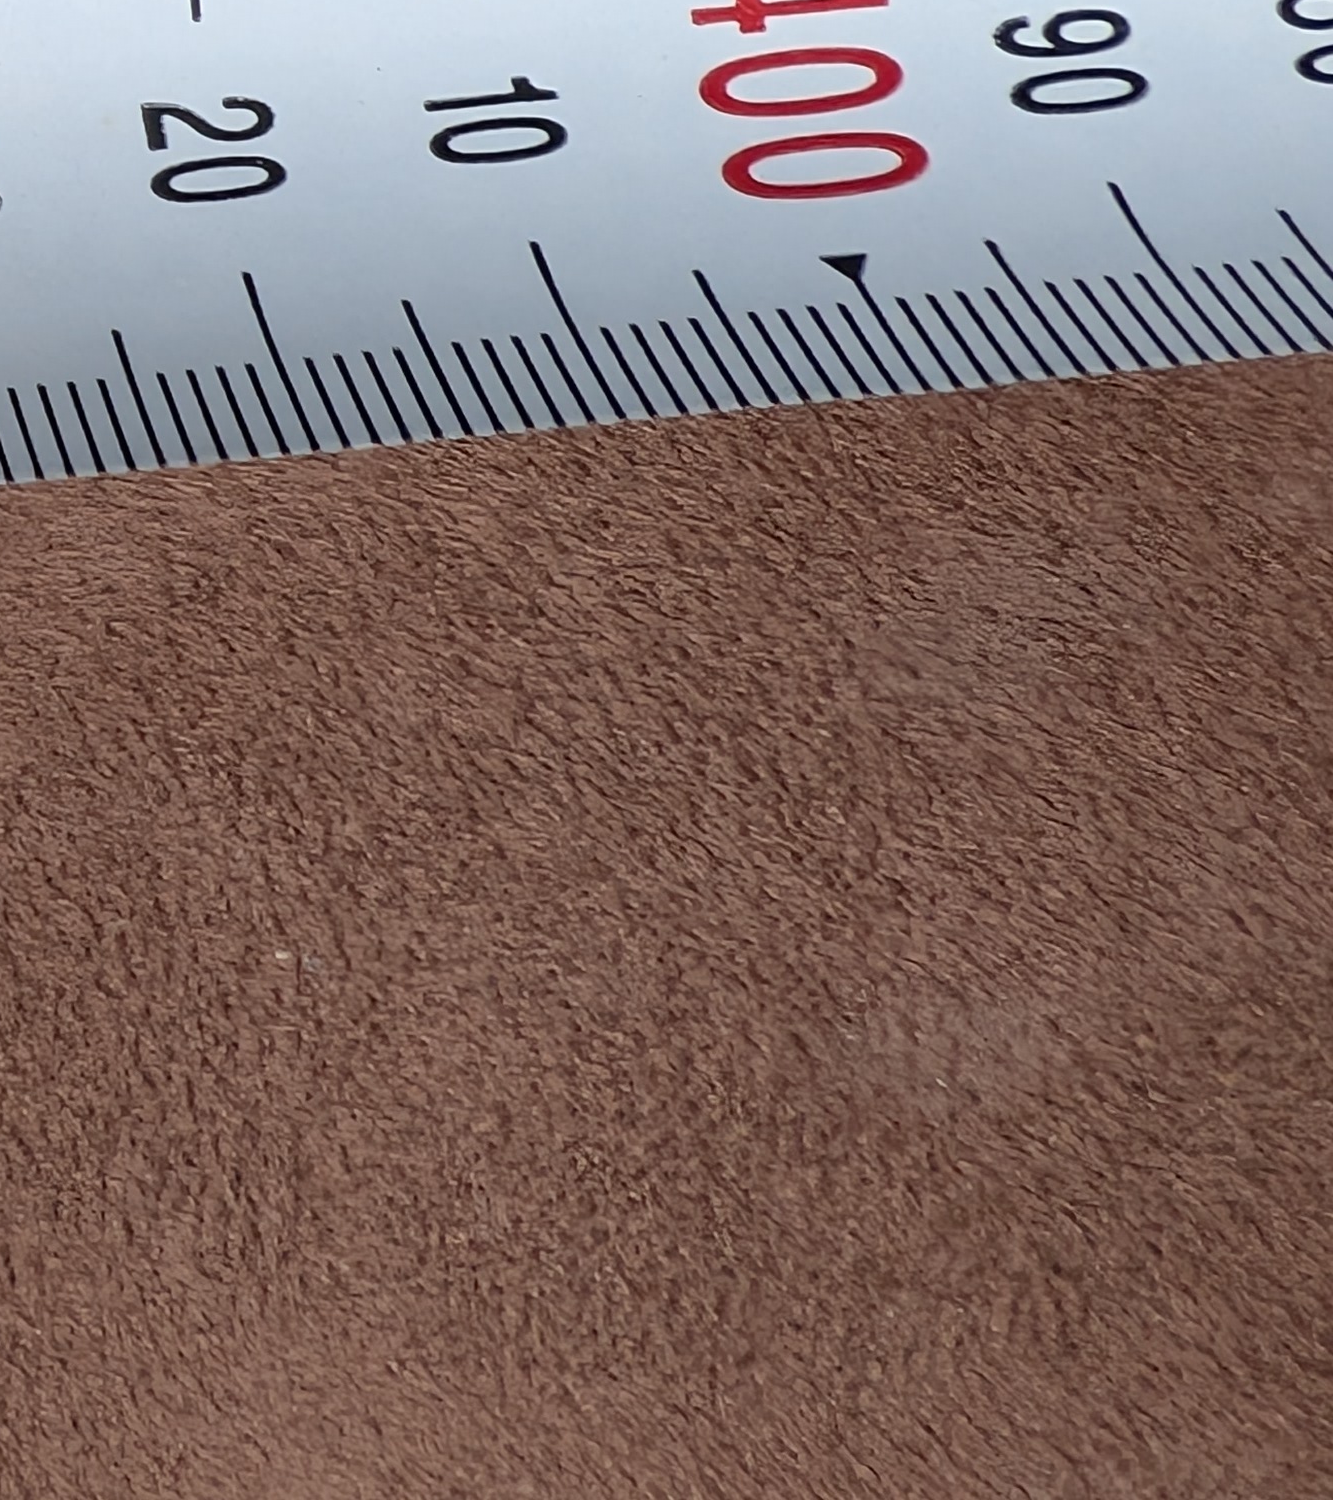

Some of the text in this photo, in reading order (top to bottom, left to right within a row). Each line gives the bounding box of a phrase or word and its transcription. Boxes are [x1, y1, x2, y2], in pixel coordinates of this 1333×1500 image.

[992, 8, 1150, 116] 90
[140, 95, 288, 205] 20
[423, 75, 569, 166] 10
